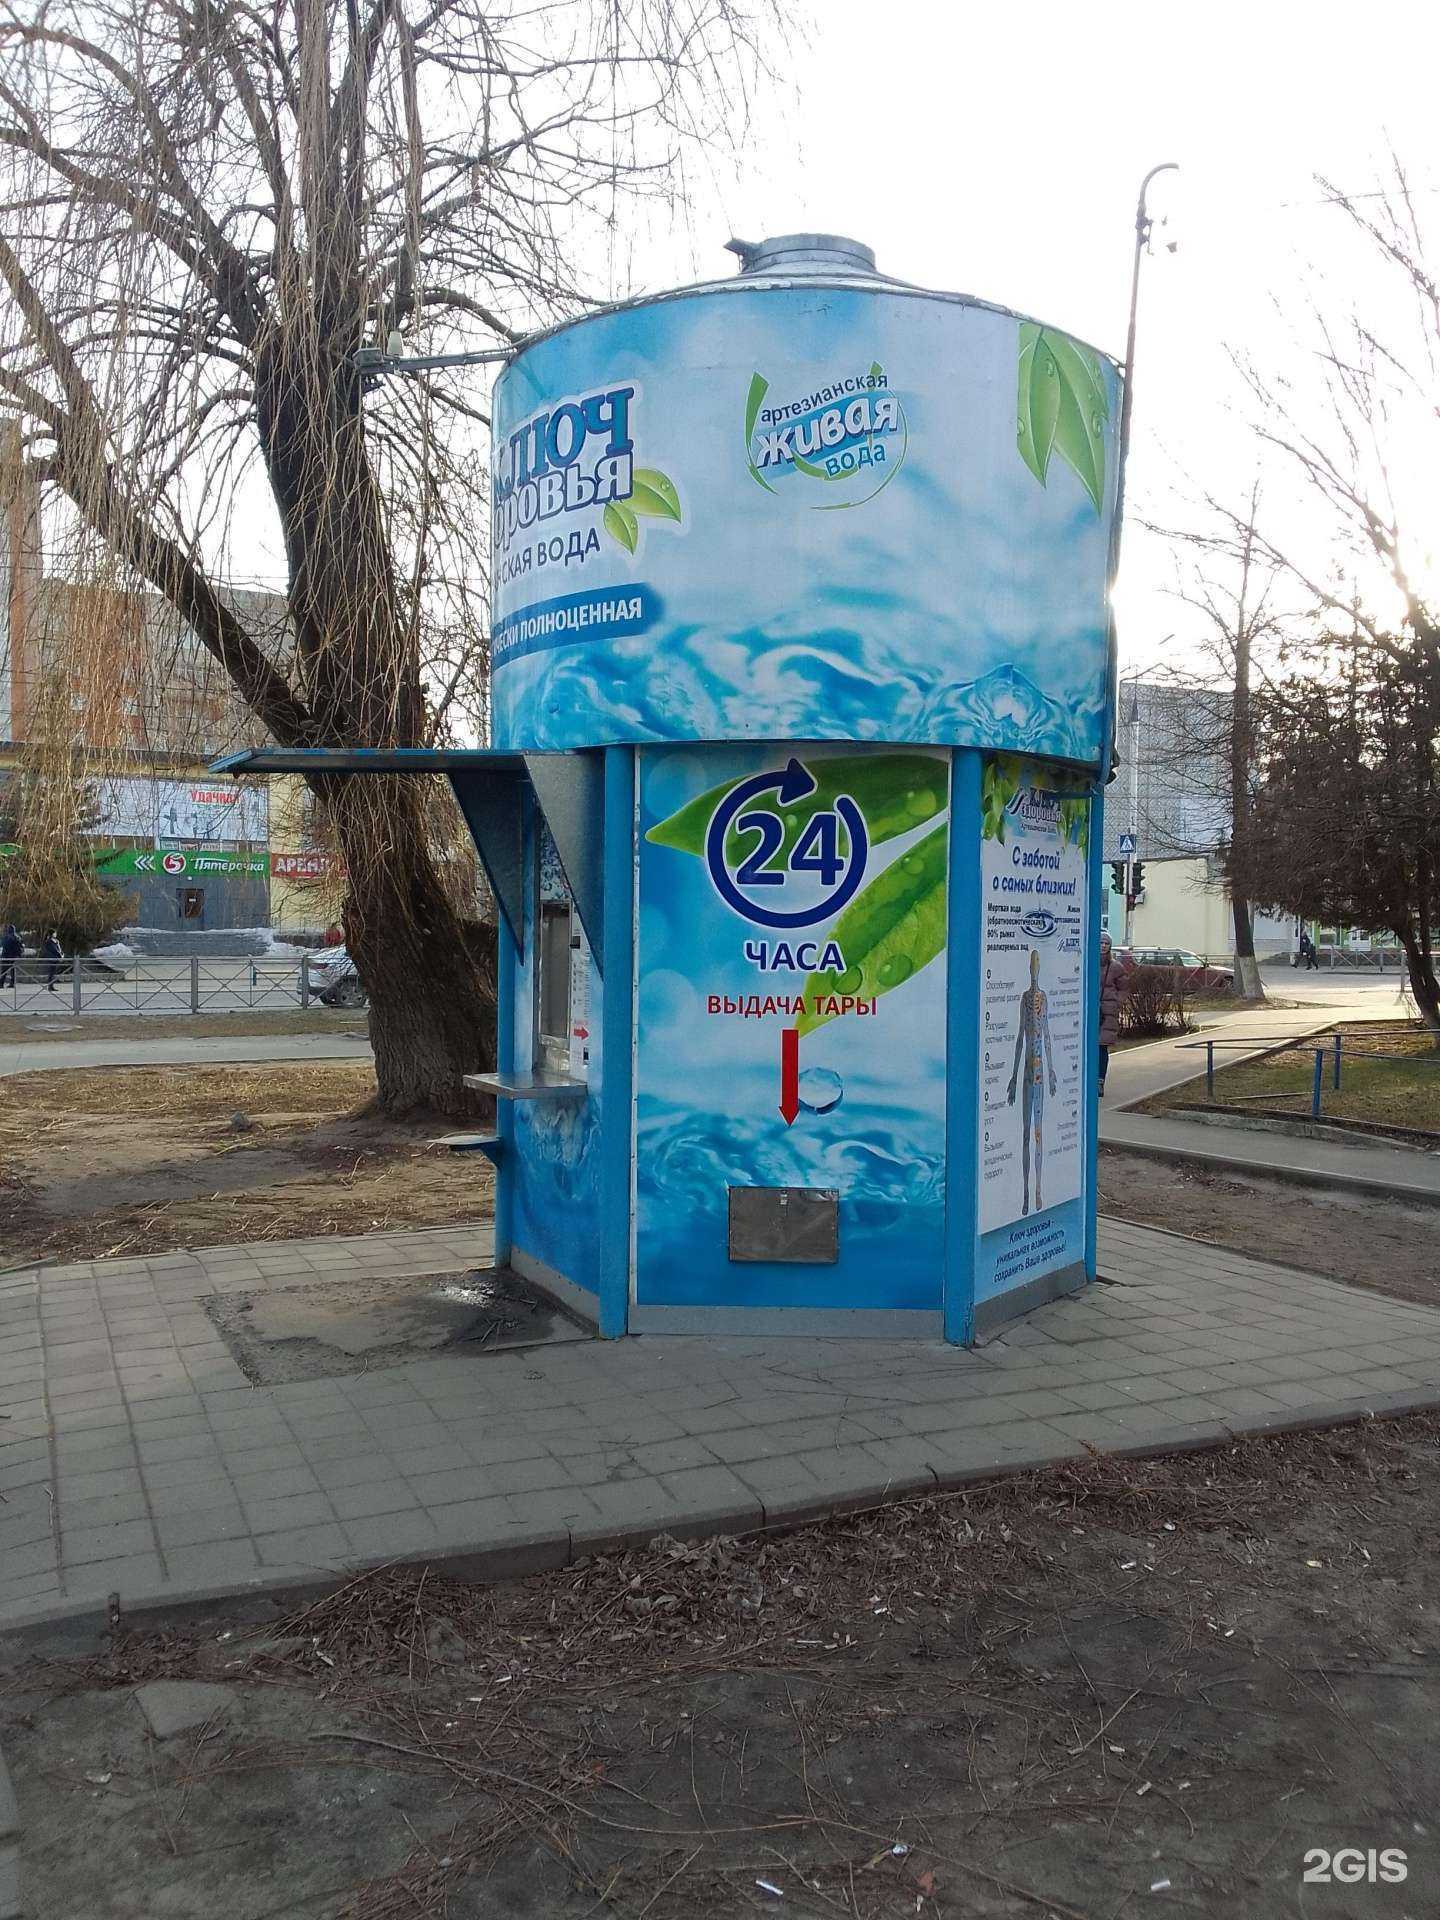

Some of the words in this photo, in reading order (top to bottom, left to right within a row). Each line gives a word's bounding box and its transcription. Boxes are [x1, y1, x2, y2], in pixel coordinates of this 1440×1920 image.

[761, 375, 888, 426] артезианская
[755, 397, 898, 469] живая
[825, 444, 886, 477] вода
[537, 527, 600, 567] ВОДА
[520, 597, 642, 641] ПОЛНОЦЕННАЯ
[736, 813, 844, 886] 24
[1012, 846, 1020, 864] С
[1022, 848, 1060, 869] заботой
[993, 876, 999, 889] о
[1002, 877, 1033, 892] самых
[1036, 874, 1076, 896] близких!
[745, 943, 845, 971] ЧАСА
[707, 995, 806, 1018] ВЫДАЧА
[813, 995, 877, 1016] ТАРЫ
